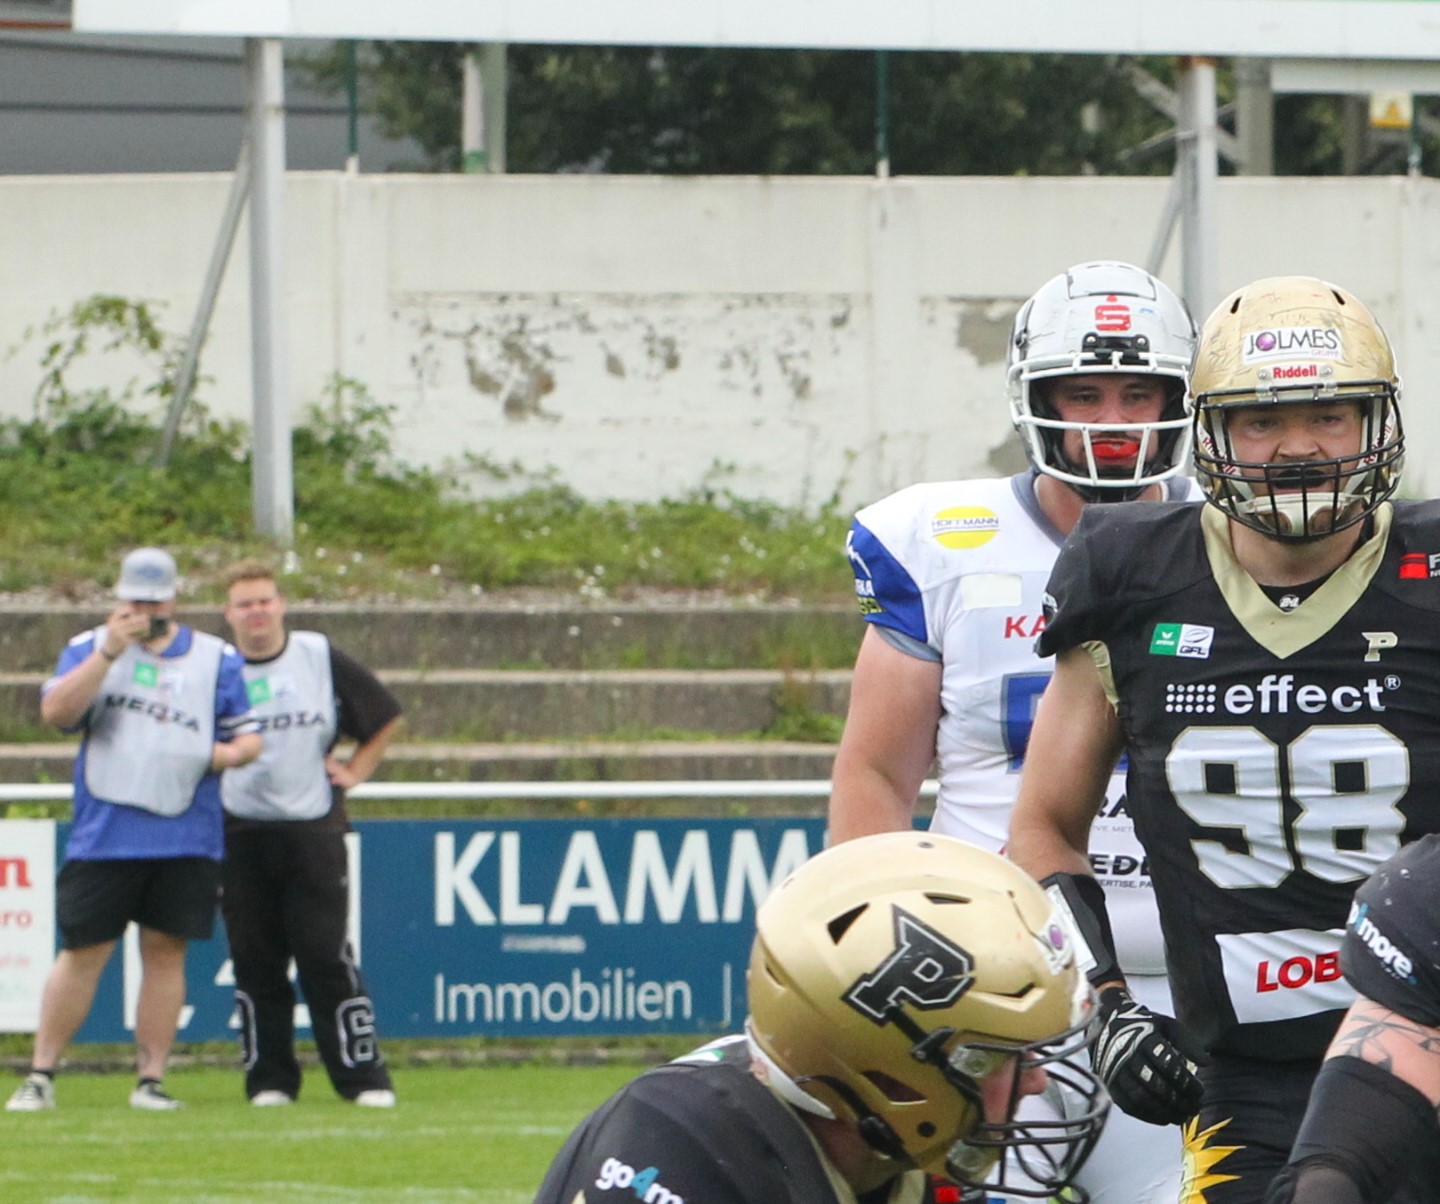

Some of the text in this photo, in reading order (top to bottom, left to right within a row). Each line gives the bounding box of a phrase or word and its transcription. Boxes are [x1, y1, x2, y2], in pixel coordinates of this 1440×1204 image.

[1273, 365, 1317, 379] Riddell
[1165, 724, 1410, 889] 98
[1256, 951, 1341, 993] LOB
[435, 970, 693, 1024] Immobilien
